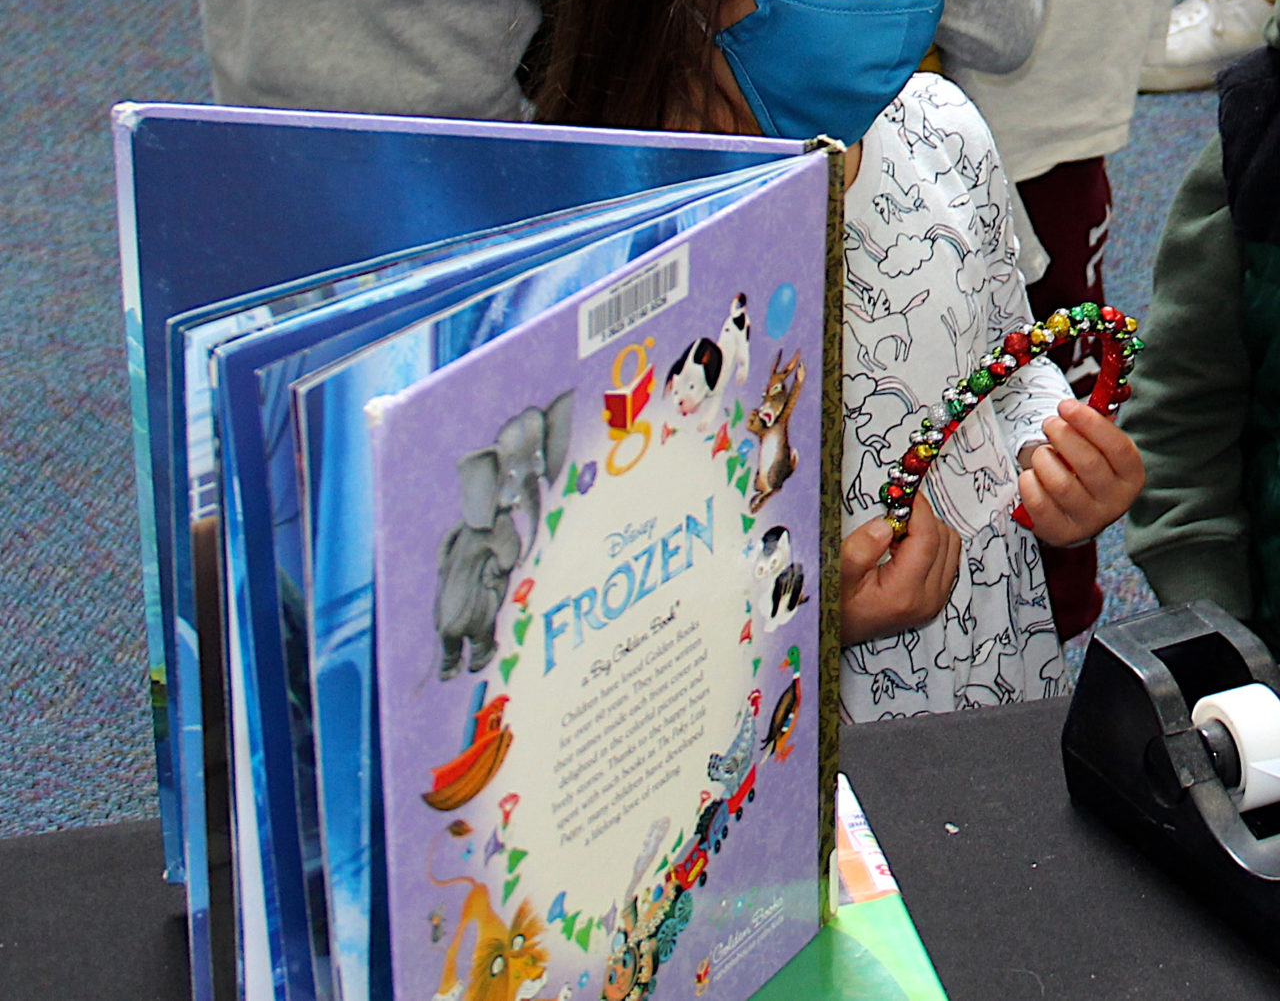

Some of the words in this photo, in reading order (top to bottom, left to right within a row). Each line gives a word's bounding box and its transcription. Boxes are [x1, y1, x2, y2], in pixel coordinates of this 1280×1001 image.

[604, 516, 658, 559] Disney
[541, 495, 714, 678] FROZEN
[561, 696, 599, 728] Children
[600, 681, 620, 699] have
[621, 659, 644, 684] loved
[645, 640, 675, 666] Golden
[676, 621, 701, 643] Books
[574, 720, 593, 738] over
[632, 676, 652, 694] They
[655, 659, 674, 677] have
[675, 638, 703, 662] written
[612, 633, 650, 663] Golden
[559, 751, 599, 789] delighted
[610, 736, 624, 750] the
[625, 706, 656, 739] colorful
[657, 687, 689, 716] pictures
[690, 670, 704, 689] and
[576, 734, 602, 756] names
[603, 713, 628, 736] inside
[629, 696, 648, 717] each
[649, 682, 669, 701] front
[670, 664, 693, 685] cover
[694, 648, 708, 668] and
[609, 745, 637, 770] Thanks
[650, 724, 663, 739] the
[664, 706, 687, 729] happy
[689, 687, 711, 708] hours
[556, 807, 580, 830] spent
[581, 791, 601, 810] with
[602, 775, 620, 794] such
[622, 757, 646, 779] books
[587, 805, 609, 825] many
[611, 776, 644, 806] children
[646, 761, 664, 778] have
[665, 724, 704, 764] developed
[591, 813, 622, 841] lifelong
[623, 799, 640, 815] love
[712, 927, 752, 964] Golden
[752, 895, 785, 929] Books
